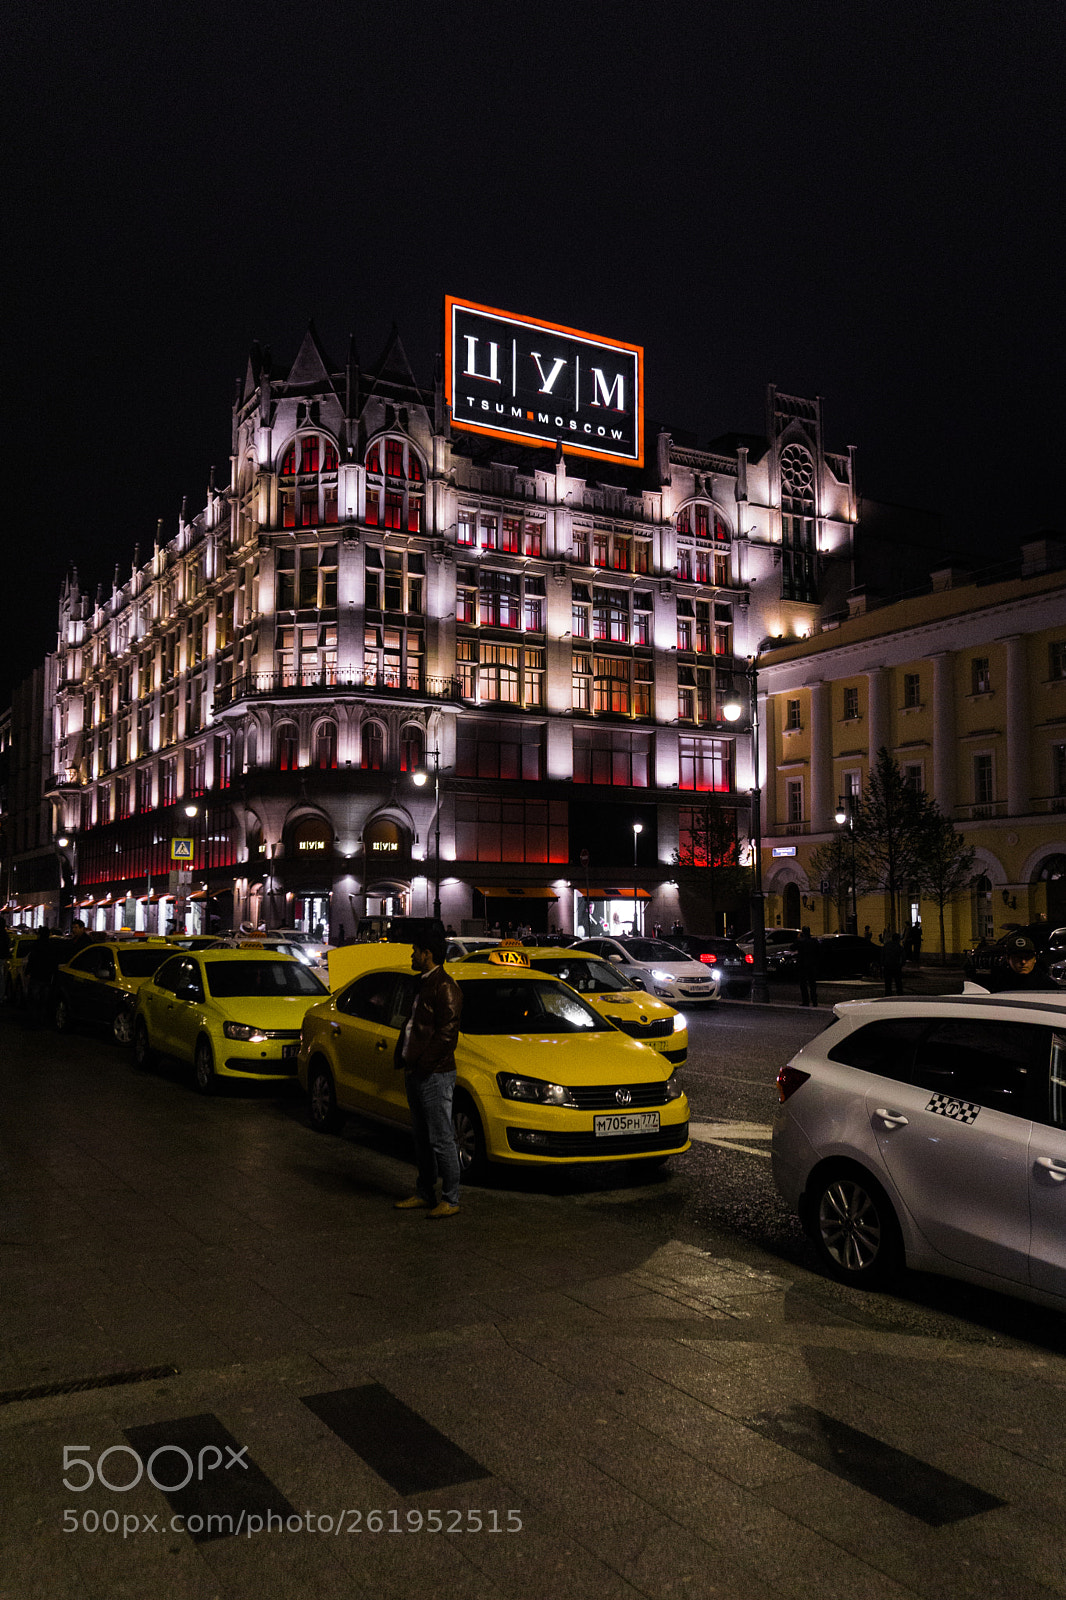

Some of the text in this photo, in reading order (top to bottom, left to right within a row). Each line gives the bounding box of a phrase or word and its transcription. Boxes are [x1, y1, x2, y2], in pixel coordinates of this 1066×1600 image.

[467, 396, 623, 440] TSUM MOSCOW
[500, 951, 527, 965] TAXI
